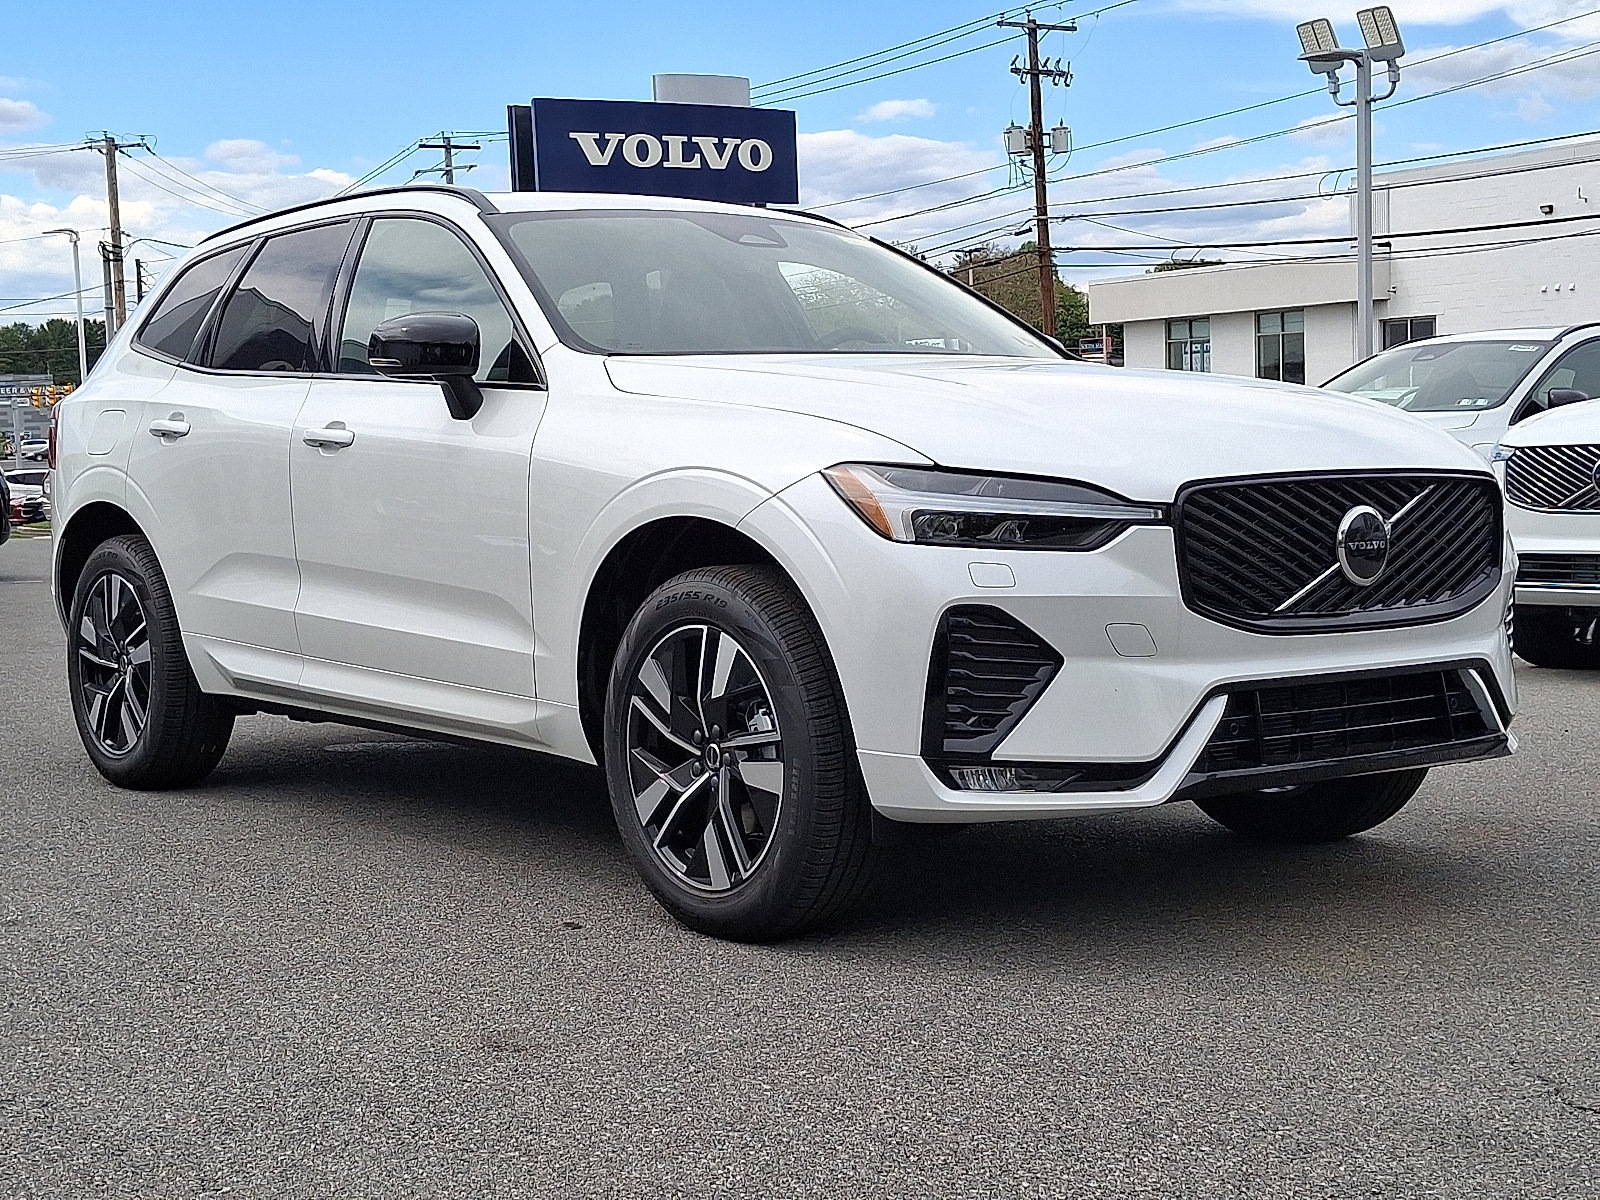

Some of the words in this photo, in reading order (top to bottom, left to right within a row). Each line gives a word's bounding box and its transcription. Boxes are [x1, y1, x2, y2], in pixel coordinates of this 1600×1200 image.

[569, 131, 773, 172] VOLVO
[1346, 540, 1386, 551] VOLVO
[655, 590, 702, 611] 235/55
[703, 593, 728, 609] R19
